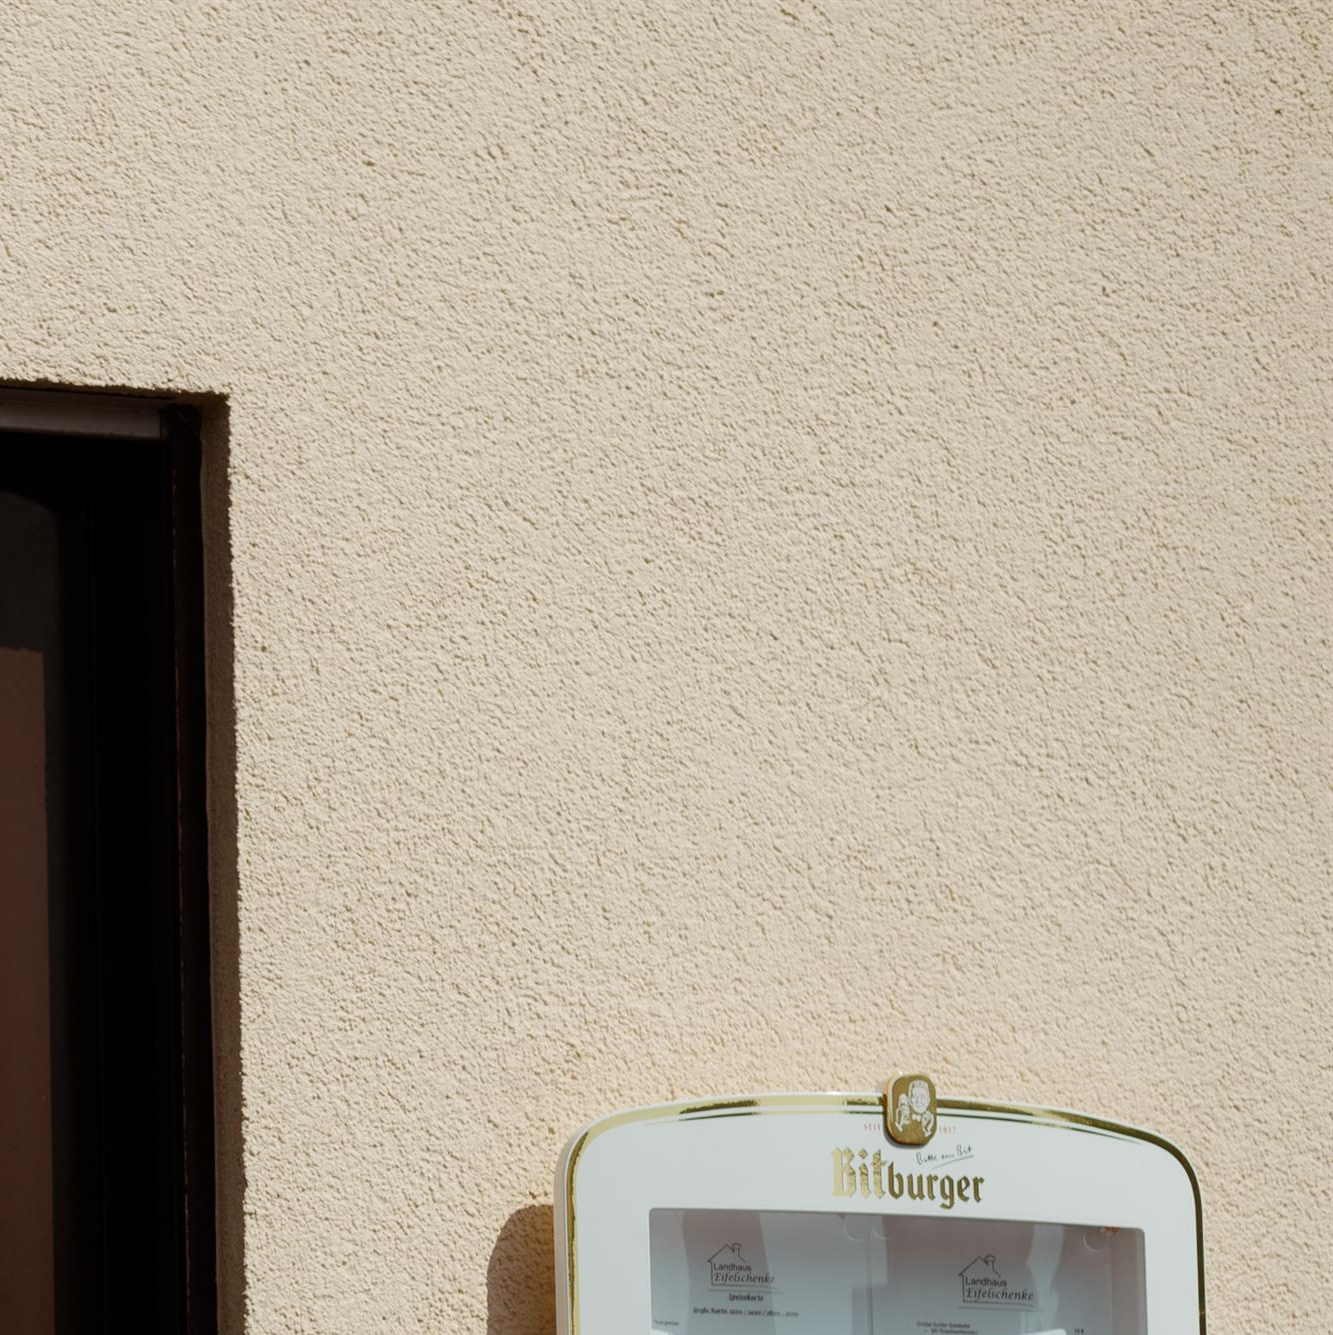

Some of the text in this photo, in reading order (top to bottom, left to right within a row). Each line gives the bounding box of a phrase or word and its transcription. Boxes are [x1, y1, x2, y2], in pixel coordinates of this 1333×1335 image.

[863, 1123, 881, 1131] SEIT
[831, 1146, 985, 1210] Bitburger
[713, 1262, 752, 1272] Landhaus
[713, 1272, 775, 1285] Eifelschenke
[965, 1277, 1008, 1287] Landhaus
[965, 1287, 1034, 1301] Eifelschenke
